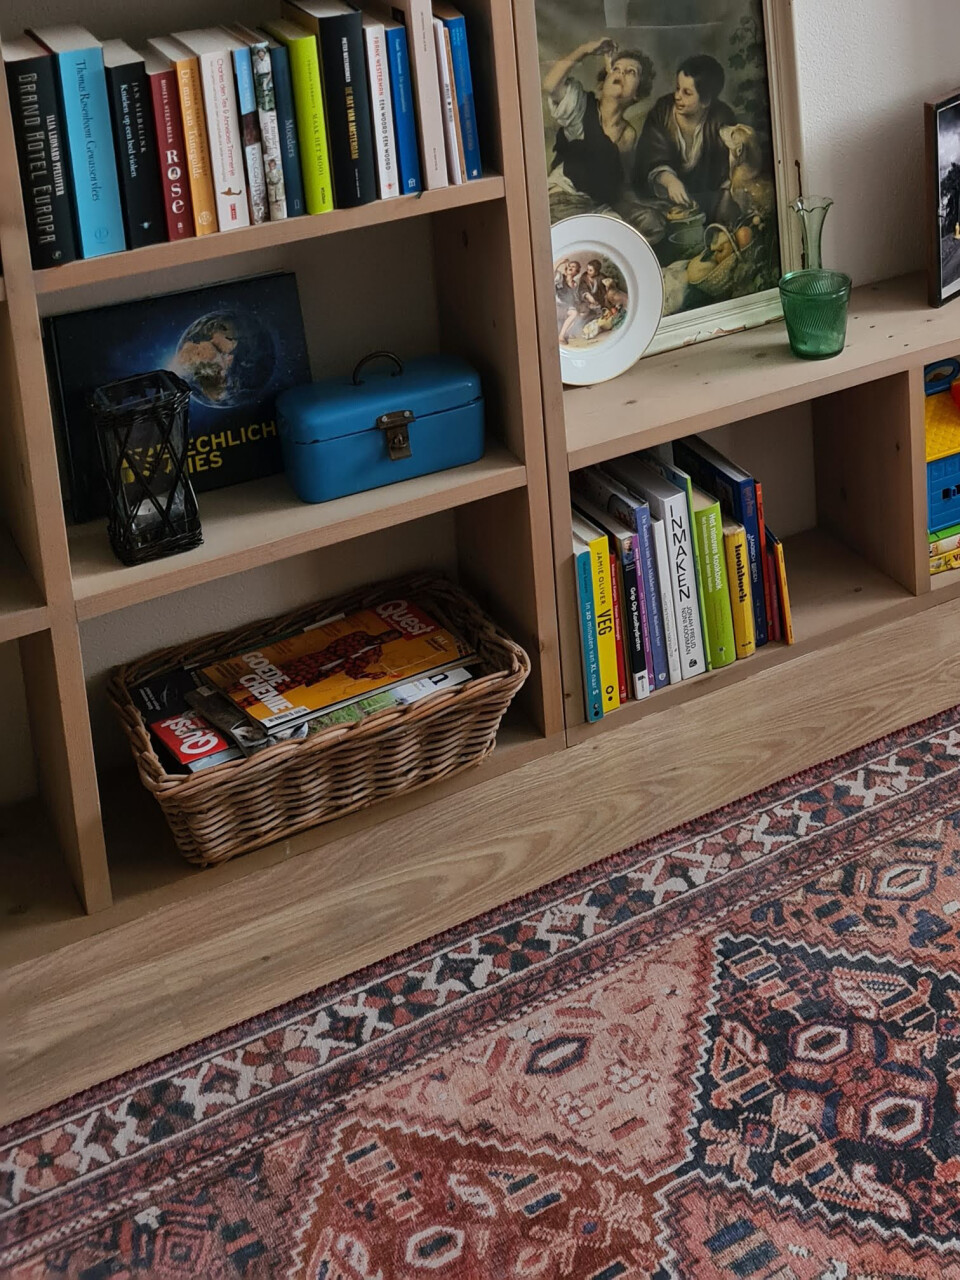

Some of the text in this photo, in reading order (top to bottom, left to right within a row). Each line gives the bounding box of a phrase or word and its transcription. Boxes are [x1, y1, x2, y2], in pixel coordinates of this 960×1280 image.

[182, 68, 191, 83] De
[218, 84, 226, 96] den
[121, 83, 129, 113] Knielen
[181, 86, 193, 107] man
[219, 97, 229, 108] Tex
[344, 95, 355, 108] RAT
[371, 36, 391, 171] FRANK WESTERMAN EEN WOORD EEN WOORD
[45, 114, 57, 130] ILJA
[74, 60, 100, 202] Thomas Rosenboom Gewassen vlees
[123, 114, 130, 126] op
[135, 101, 147, 153] SIEBELINK
[165, 104, 173, 143] STEENBEEK
[187, 110, 195, 126] van
[345, 108, 356, 121] VAN
[47, 131, 61, 161] LEONARD
[284, 118, 296, 159] Moeders
[346, 121, 358, 160] AMSTERDAM
[18, 73, 56, 245] GRAND HOTEL EUROPA
[707, 512, 717, 527] Het
[639, 514, 647, 523] De
[644, 558, 652, 568] het
[669, 505, 691, 603] INMAKEN
[708, 527, 719, 553] nieuwe
[711, 554, 721, 590] kookboek
[736, 543, 748, 603] kookboek
[376, 600, 435, 636] Quest
[584, 601, 592, 610] In
[585, 610, 593, 620] 20
[595, 608, 612, 636] VEG
[631, 601, 638, 611] Op
[633, 611, 643, 651] Koolhydraten
[680, 607, 692, 655] NONI KOOIMAN
[685, 605, 697, 648] JONAH FREUD
[242, 651, 292, 690] GOEDE
[589, 663, 597, 673] XL
[239, 674, 295, 714] CHEMIE
[161, 718, 219, 755] Quest
